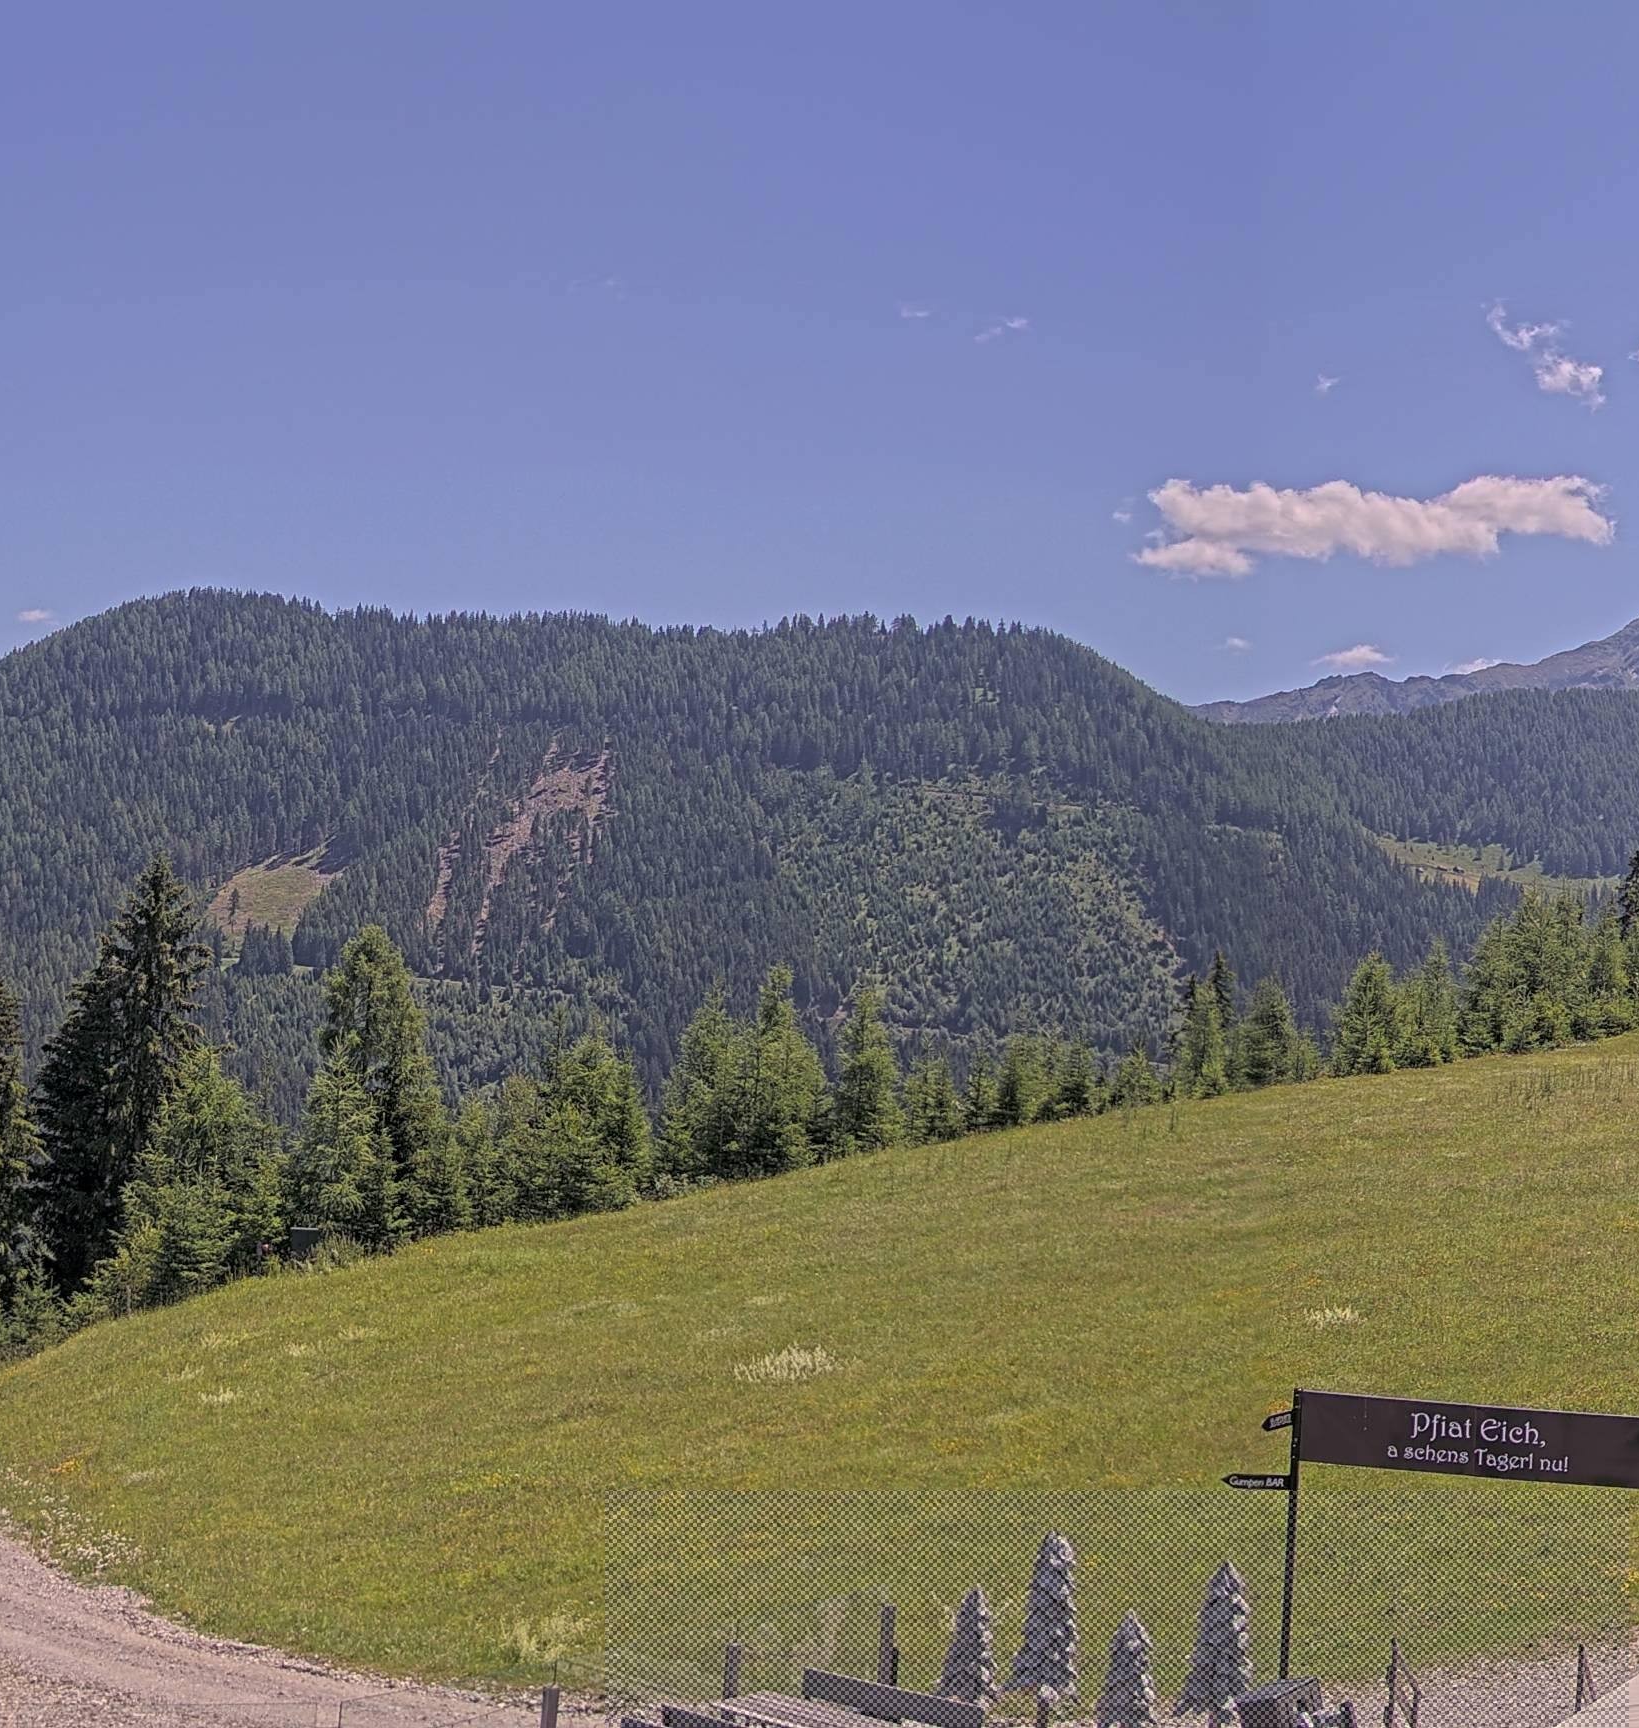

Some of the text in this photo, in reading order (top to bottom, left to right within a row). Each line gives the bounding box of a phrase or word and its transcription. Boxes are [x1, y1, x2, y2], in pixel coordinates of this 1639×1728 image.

[1410, 1412, 1546, 1448] Pfiat Eich,
[1387, 1444, 1570, 1473] a schens Tagerl nu!
[1229, 1475, 1284, 1488] Gumpen BAR
